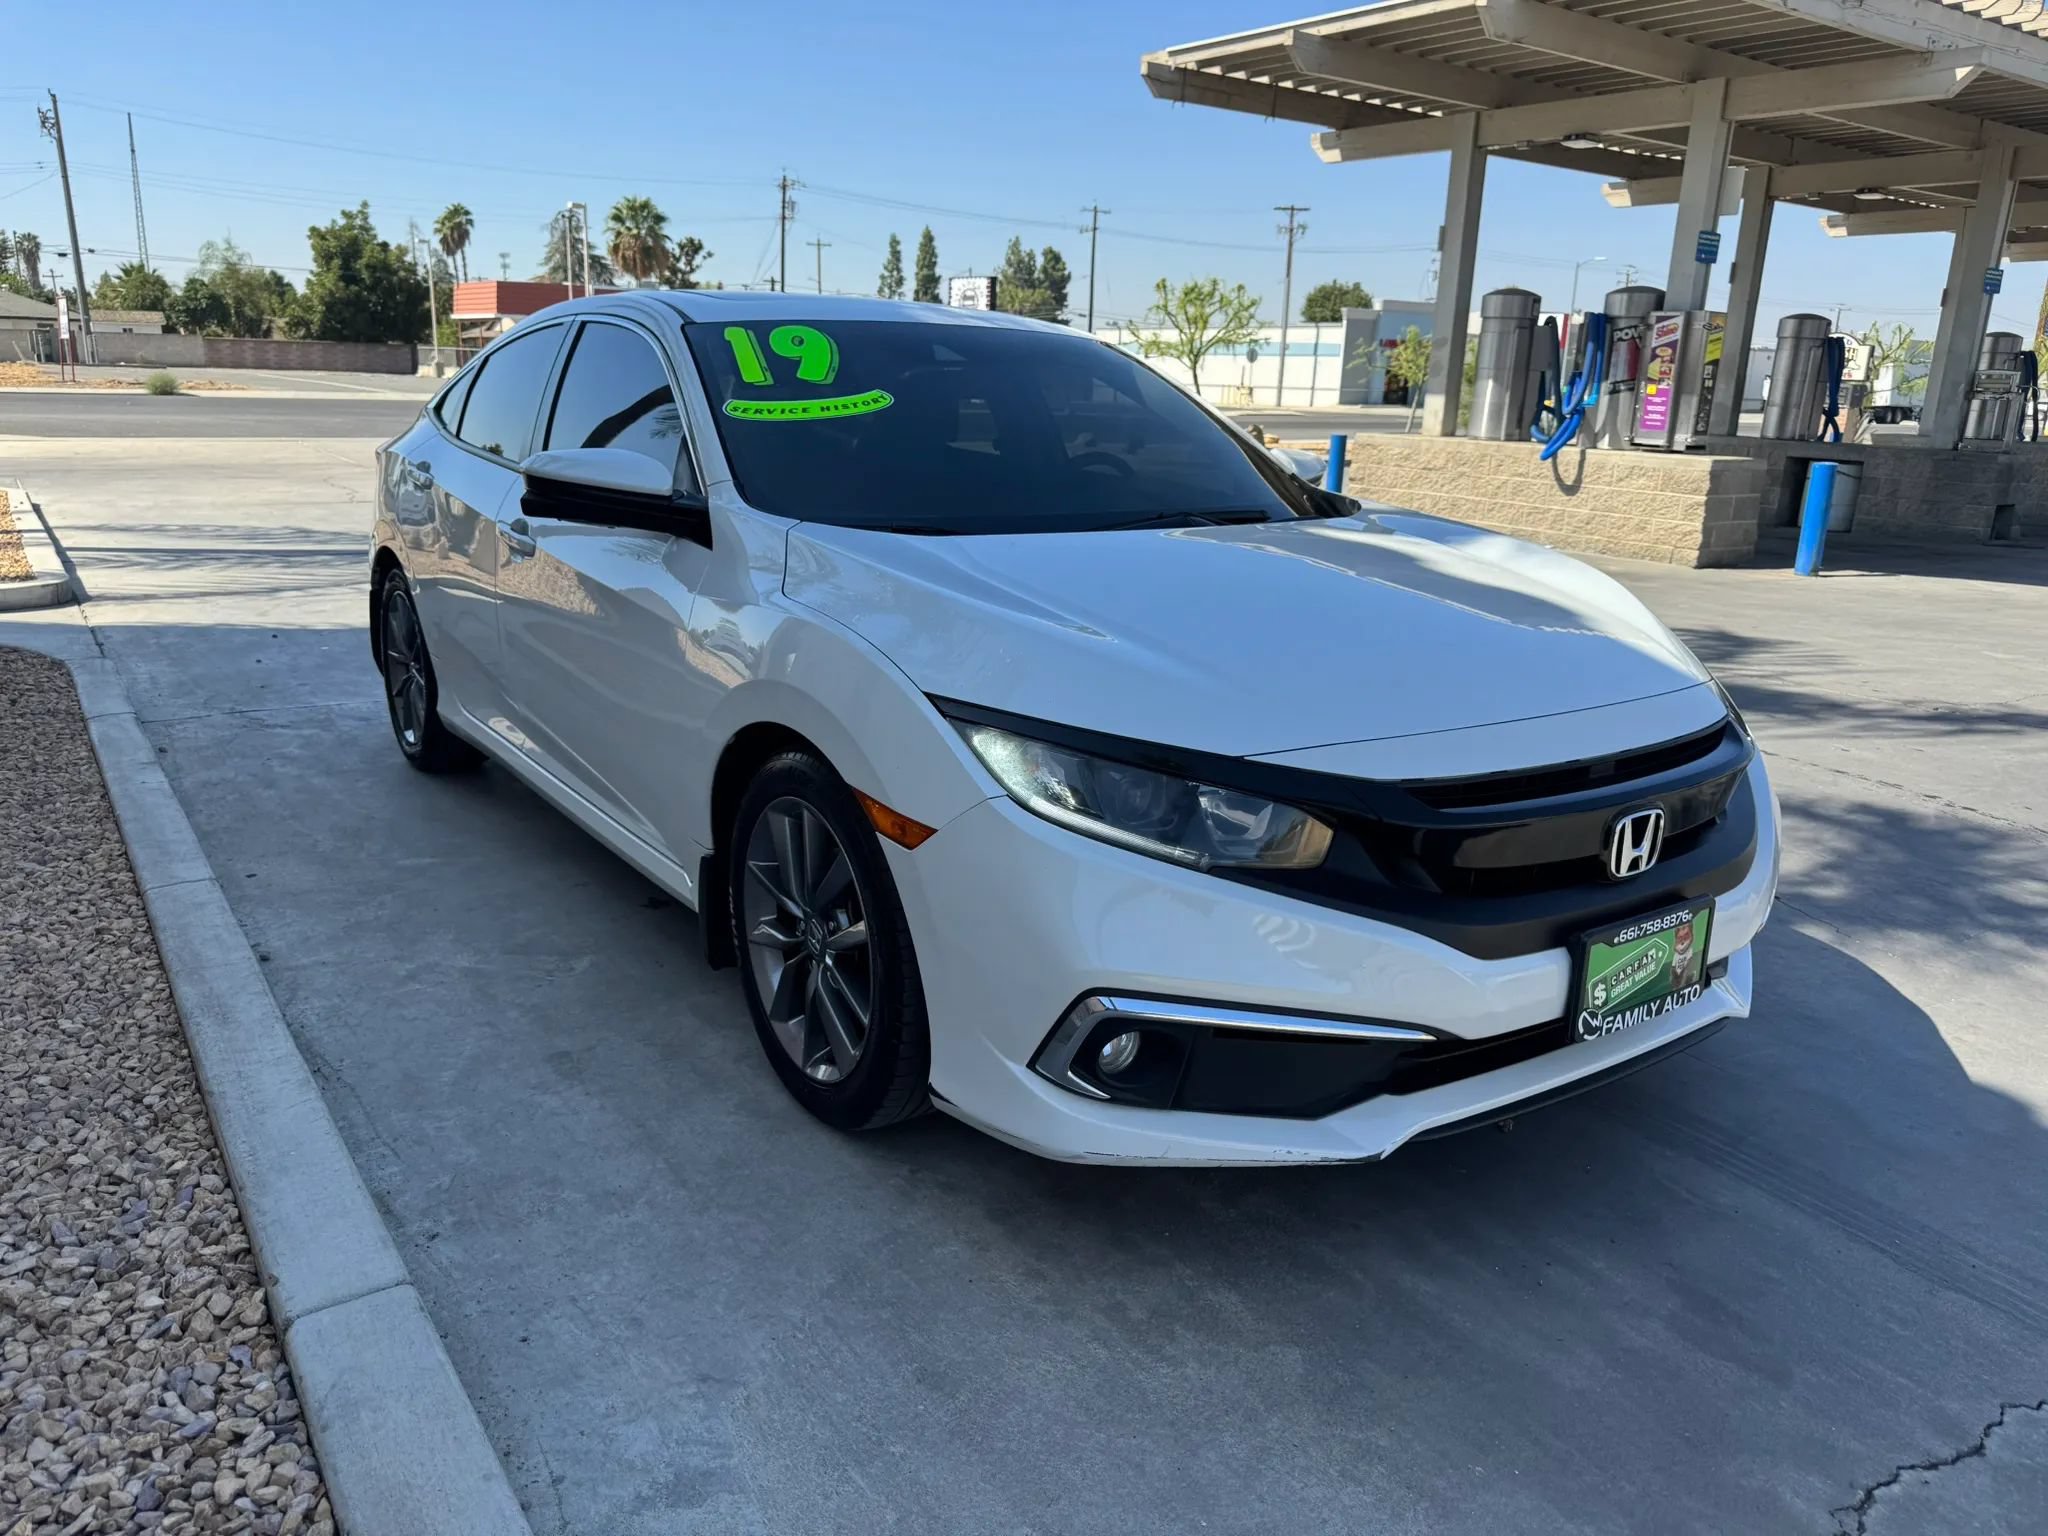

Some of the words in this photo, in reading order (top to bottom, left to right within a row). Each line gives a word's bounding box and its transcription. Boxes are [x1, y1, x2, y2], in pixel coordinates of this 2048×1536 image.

[724, 325, 839, 385] 19
[729, 405, 811, 415] SERVICE
[820, 394, 888, 412] HISTORY
[1610, 976, 1634, 998] GREAT
[1634, 961, 1657, 982] VALUE
[1602, 1000, 1661, 1037] FAMILY
[1661, 983, 1700, 1015] AUTO
